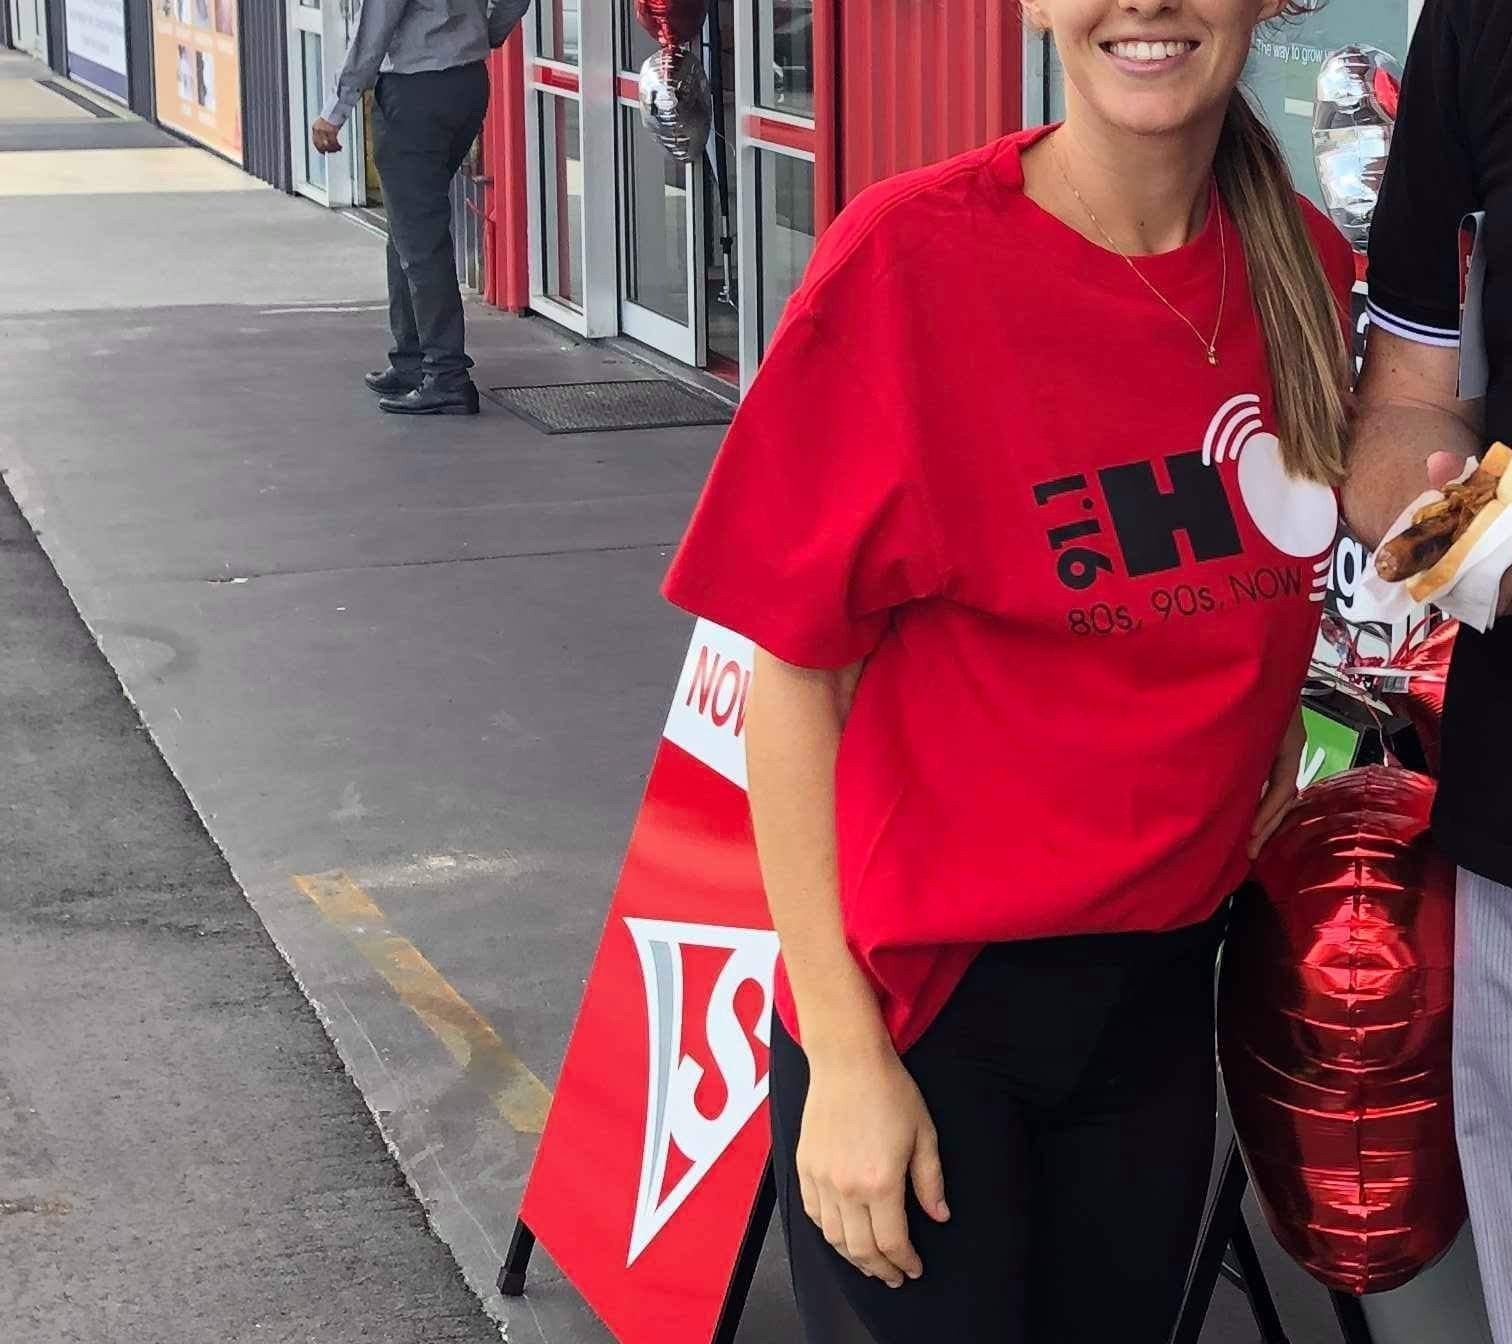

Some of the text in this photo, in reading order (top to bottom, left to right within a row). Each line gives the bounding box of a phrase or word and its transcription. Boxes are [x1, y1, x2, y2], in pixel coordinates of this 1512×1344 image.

[1256, 38, 1272, 57] The
[1273, 42, 1290, 64] way
[1291, 43, 1301, 60] to
[1301, 46, 1322, 66] grow
[1228, 566, 1302, 604] NOW
